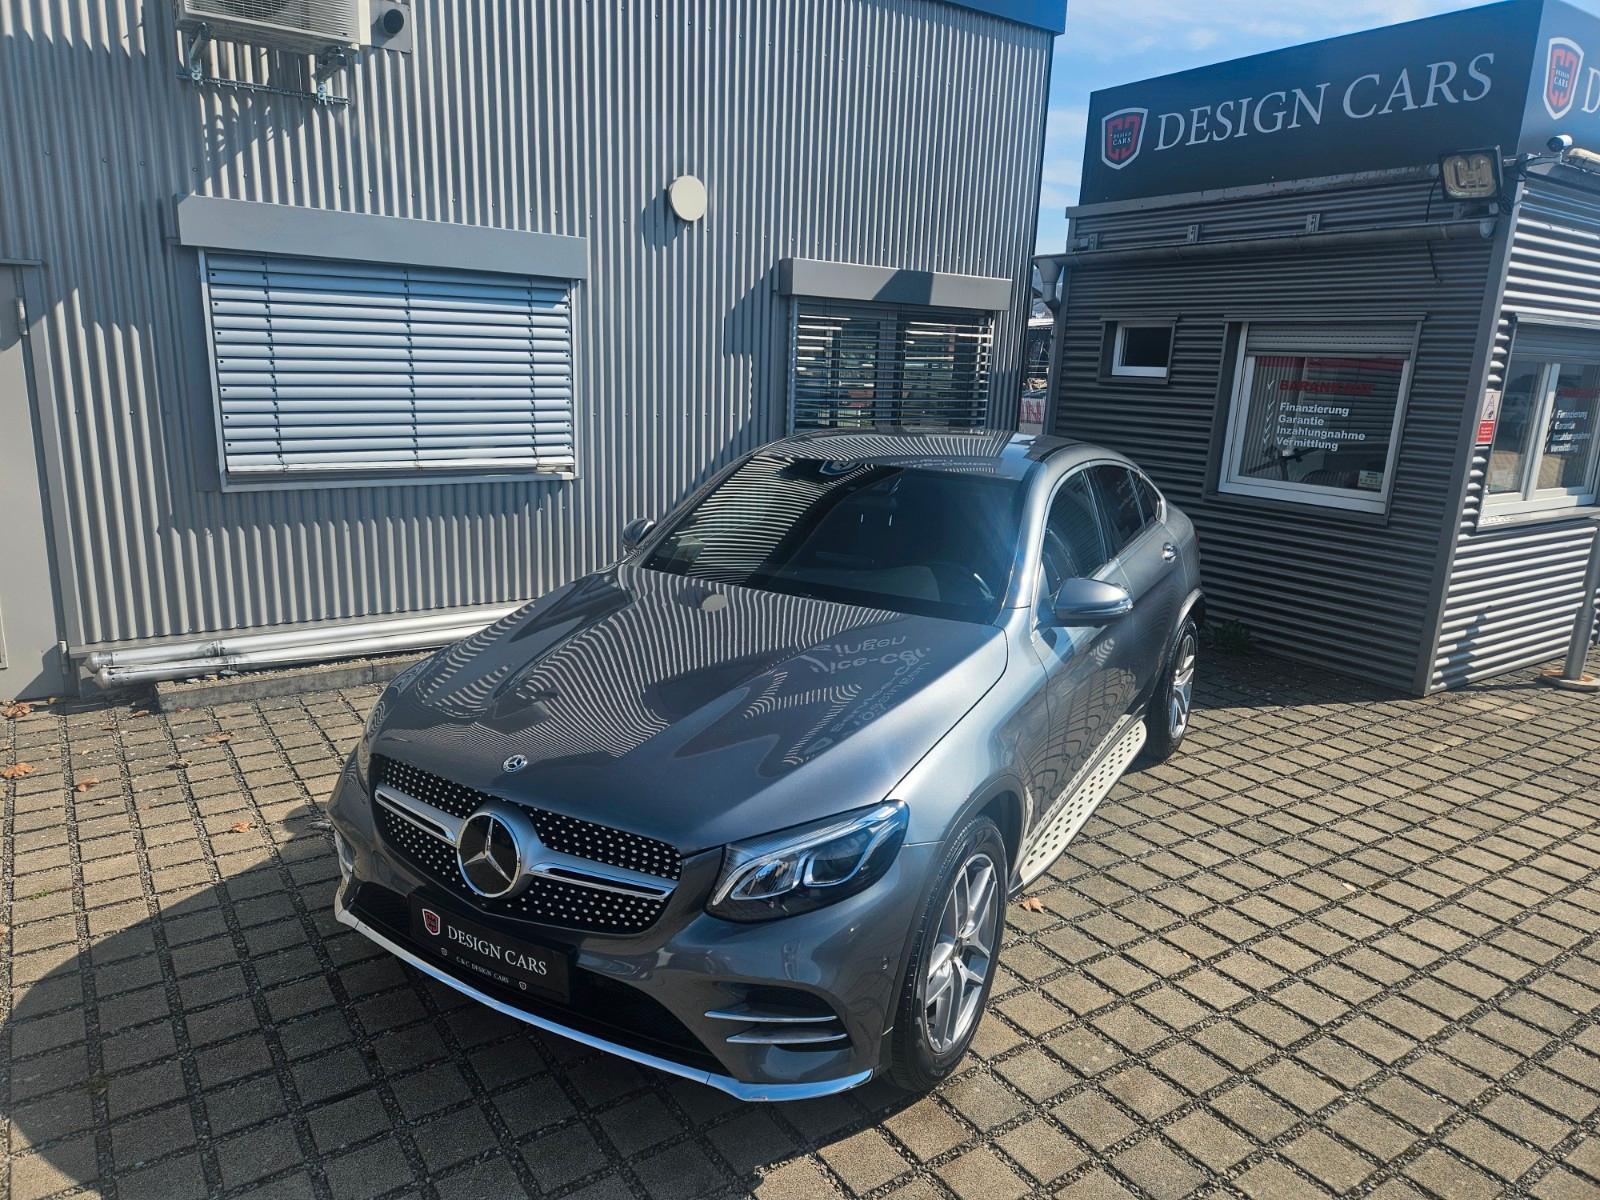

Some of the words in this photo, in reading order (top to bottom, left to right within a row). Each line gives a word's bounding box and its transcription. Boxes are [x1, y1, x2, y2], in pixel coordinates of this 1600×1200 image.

[1153, 82, 1331, 152] DESIGN
[1342, 52, 1495, 120] CARS
[1280, 402, 1349, 417] Finanzierung
[1278, 414, 1325, 426] Garantie
[1277, 426, 1366, 441] Inzahlungnahme
[1277, 437, 1338, 452] Vermittlung
[447, 925, 501, 959] DESIGN
[504, 950, 547, 975] CARS
